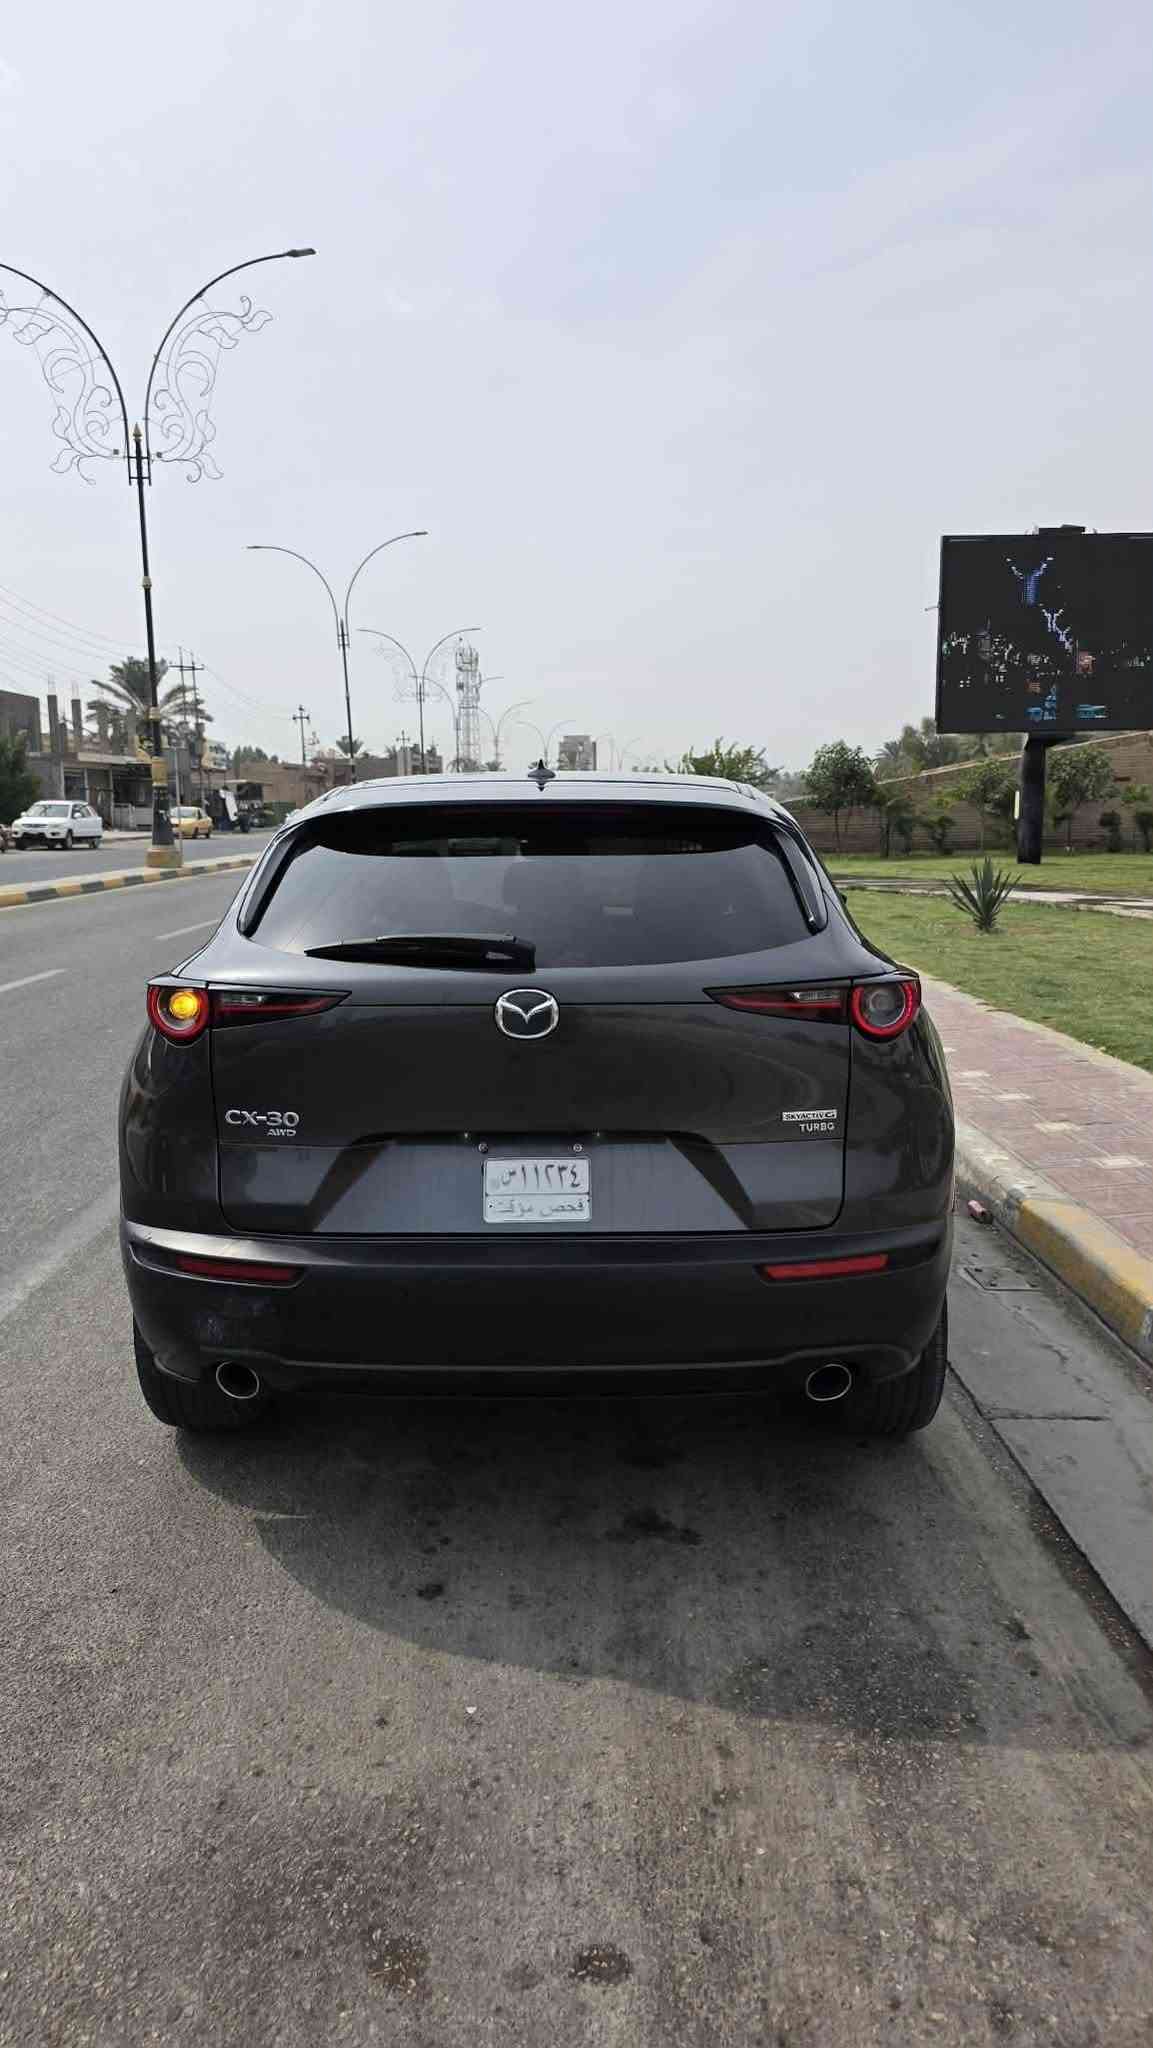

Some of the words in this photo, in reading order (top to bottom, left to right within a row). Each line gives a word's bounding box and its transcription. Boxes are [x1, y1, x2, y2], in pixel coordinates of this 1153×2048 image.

[225, 1109, 300, 1127] CX-30
[799, 1122, 835, 1132] TURBO
[267, 1128, 297, 1137] AWD
